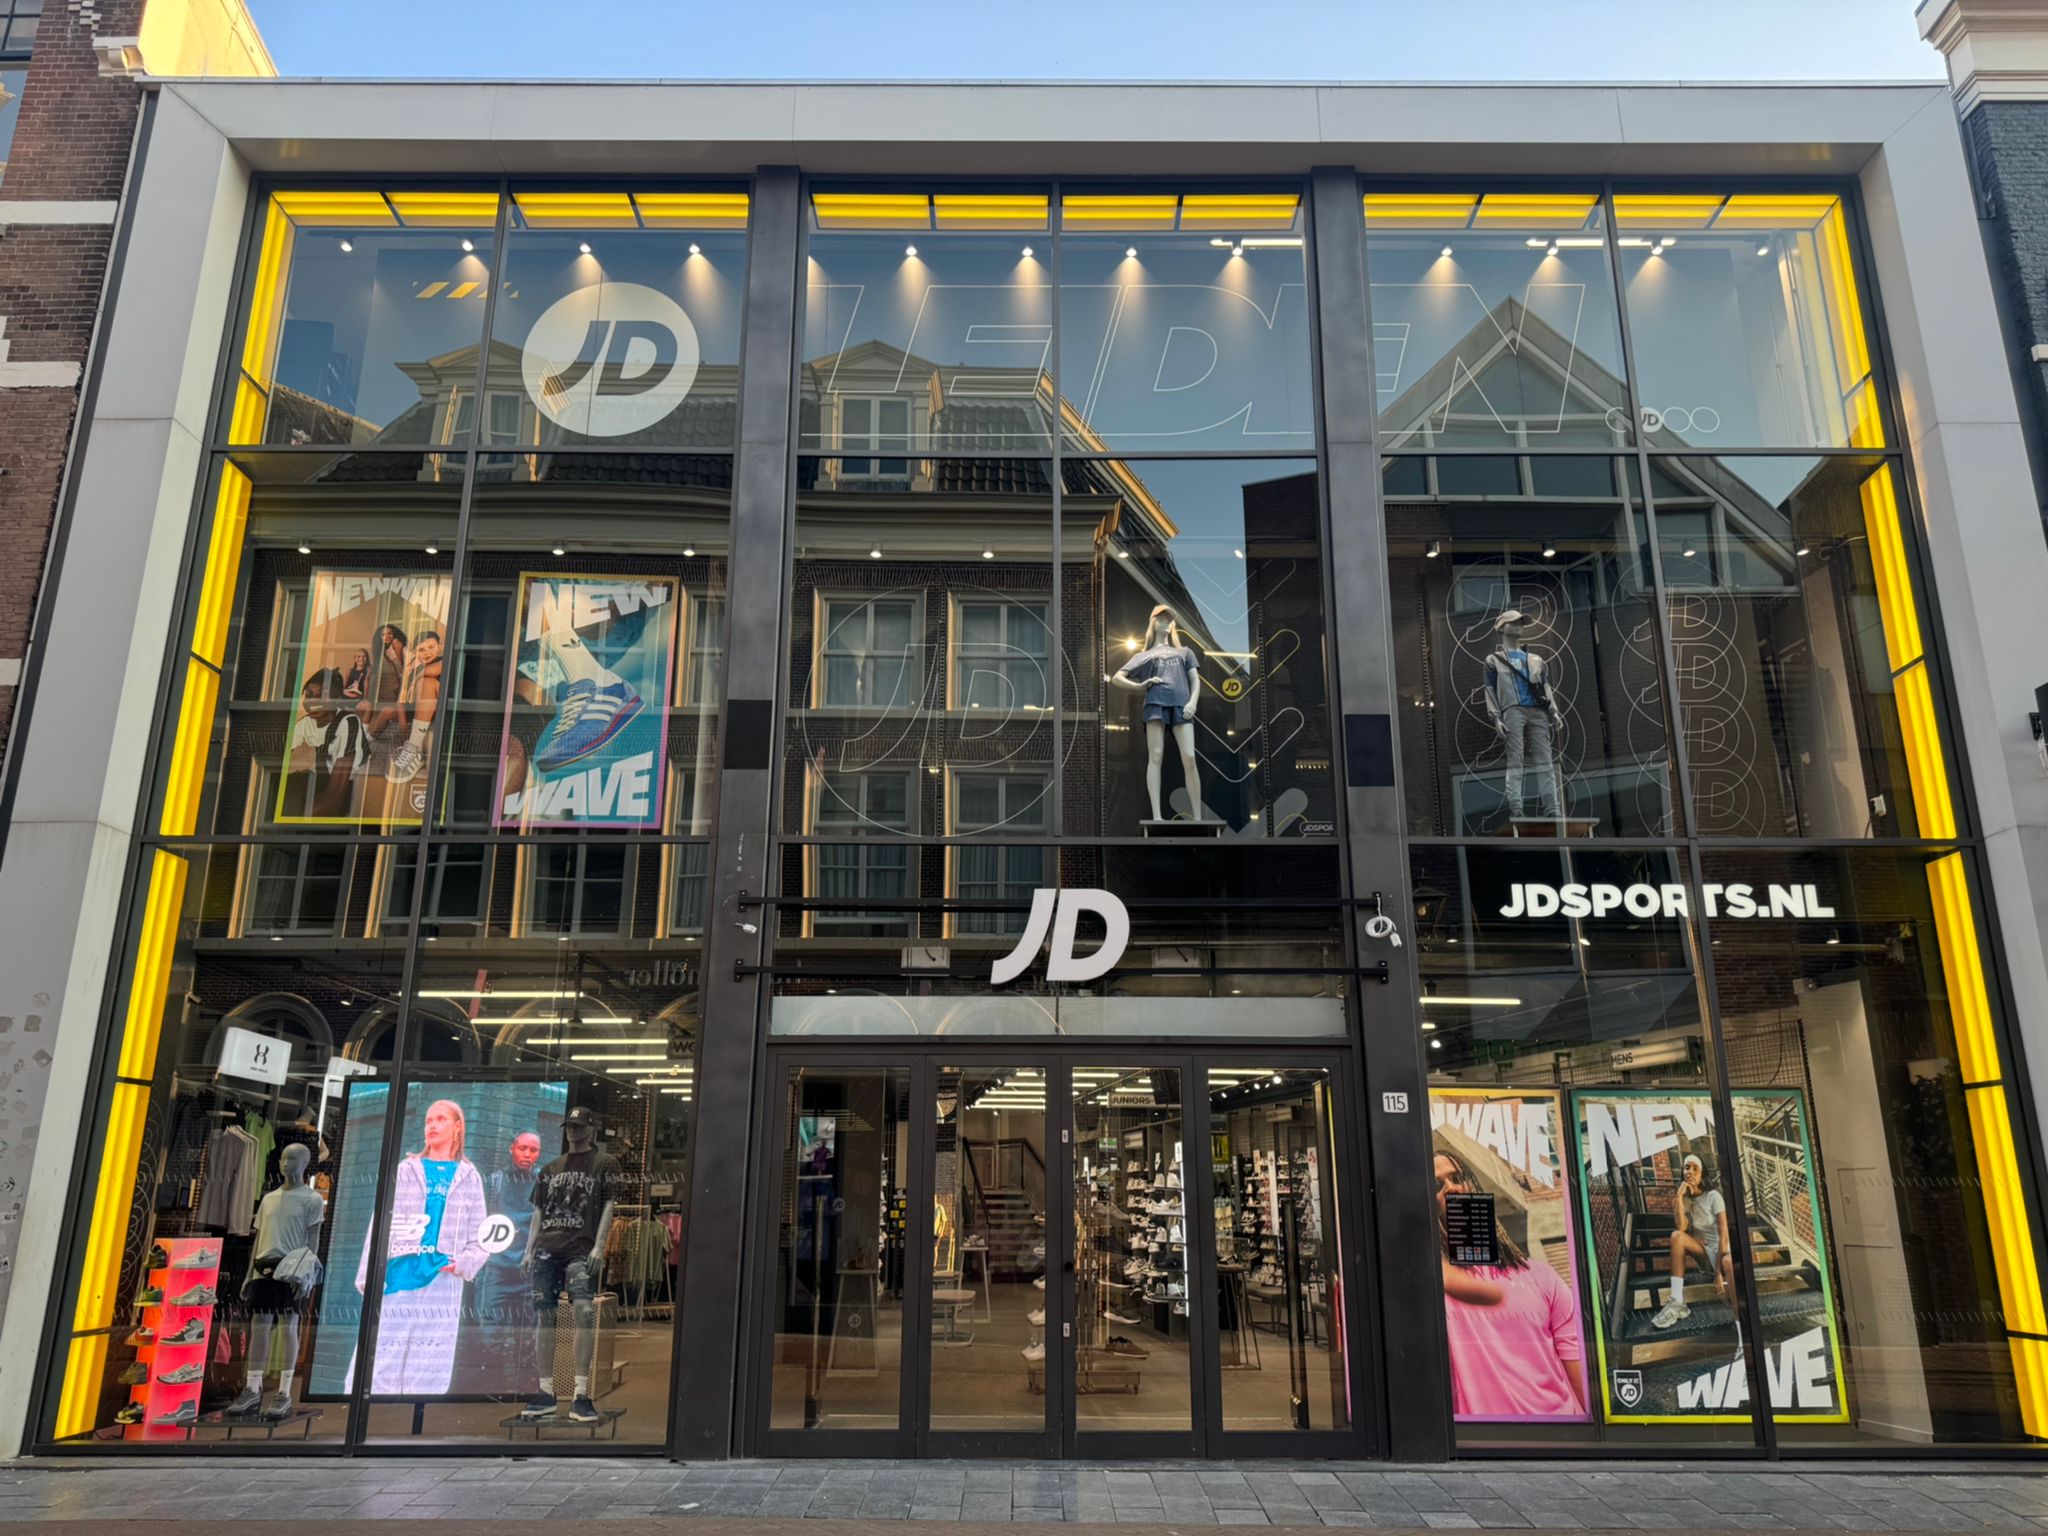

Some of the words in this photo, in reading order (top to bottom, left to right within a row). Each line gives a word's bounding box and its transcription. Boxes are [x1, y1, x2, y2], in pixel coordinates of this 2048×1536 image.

[544, 320, 678, 396] JD
[526, 582, 669, 642] NEW
[839, 643, 1047, 773] JD
[1225, 682, 1239, 692] JD
[503, 751, 653, 817] WAVE
[1499, 883, 1835, 918] JDSPORTS.NL
[991, 888, 1131, 984] JD
[1610, 1052, 1634, 1066] MENS
[1112, 1096, 1150, 1105] JUNIORS
[1386, 1094, 1405, 1111] 115
[1446, 1103, 1555, 1189] WAVE
[483, 1224, 510, 1243] JD
[1677, 1326, 1833, 1408] WAVE
[1624, 1388, 1635, 1397] JD
